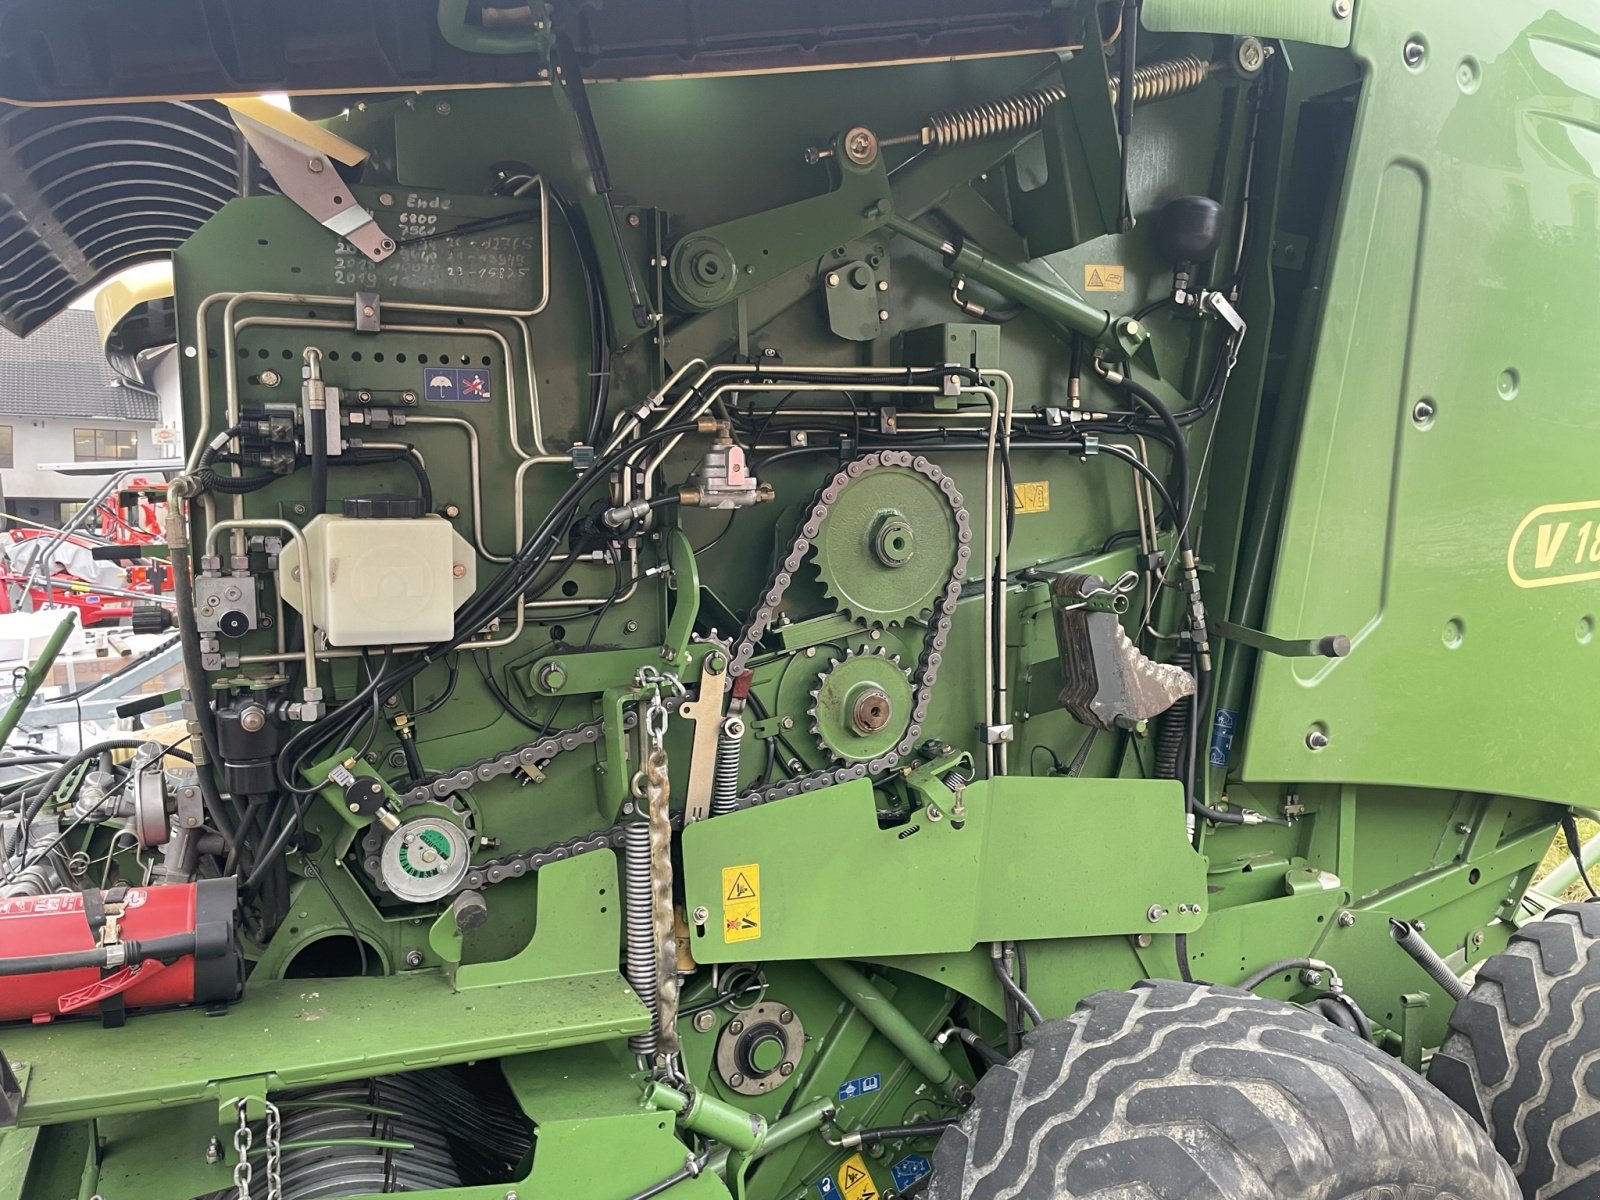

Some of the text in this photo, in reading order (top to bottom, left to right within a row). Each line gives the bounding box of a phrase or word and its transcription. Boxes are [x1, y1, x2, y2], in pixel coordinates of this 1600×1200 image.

[406, 193, 453, 211] Ende
[399, 212, 438, 225] 6800
[1534, 522, 1571, 569] V
